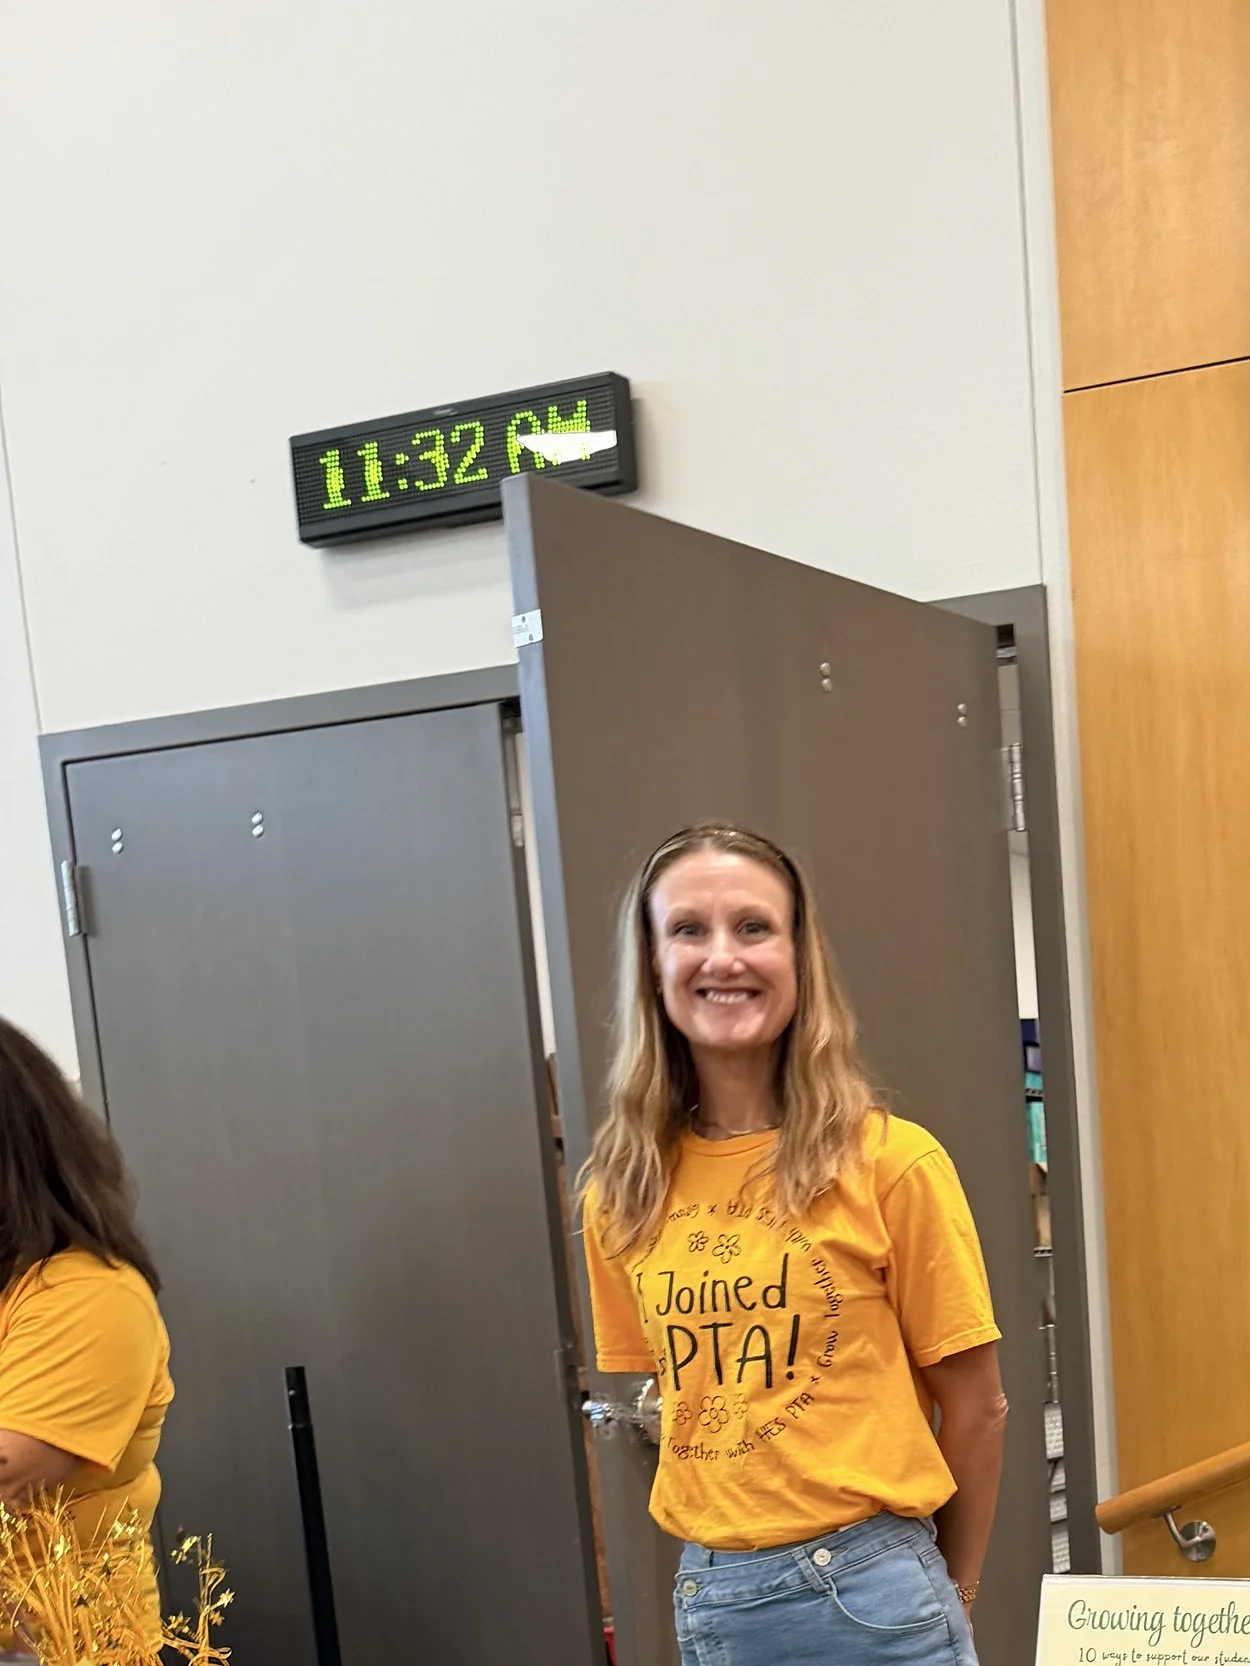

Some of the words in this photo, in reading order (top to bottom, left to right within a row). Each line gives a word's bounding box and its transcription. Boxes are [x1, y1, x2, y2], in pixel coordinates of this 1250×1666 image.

[319, 422, 489, 510] 11:32
[655, 1253, 788, 1317] Joined
[666, 1314, 800, 1391] PTA!
[816, 1330, 838, 1367] Grow
[785, 1392, 815, 1420] PTA
[1067, 1599, 1166, 1647] Growing
[1078, 1647, 1097, 1663] 10
[1131, 1647, 1142, 1663] to
[1146, 1649, 1188, 1666] support
[1191, 1654, 1210, 1663] our
